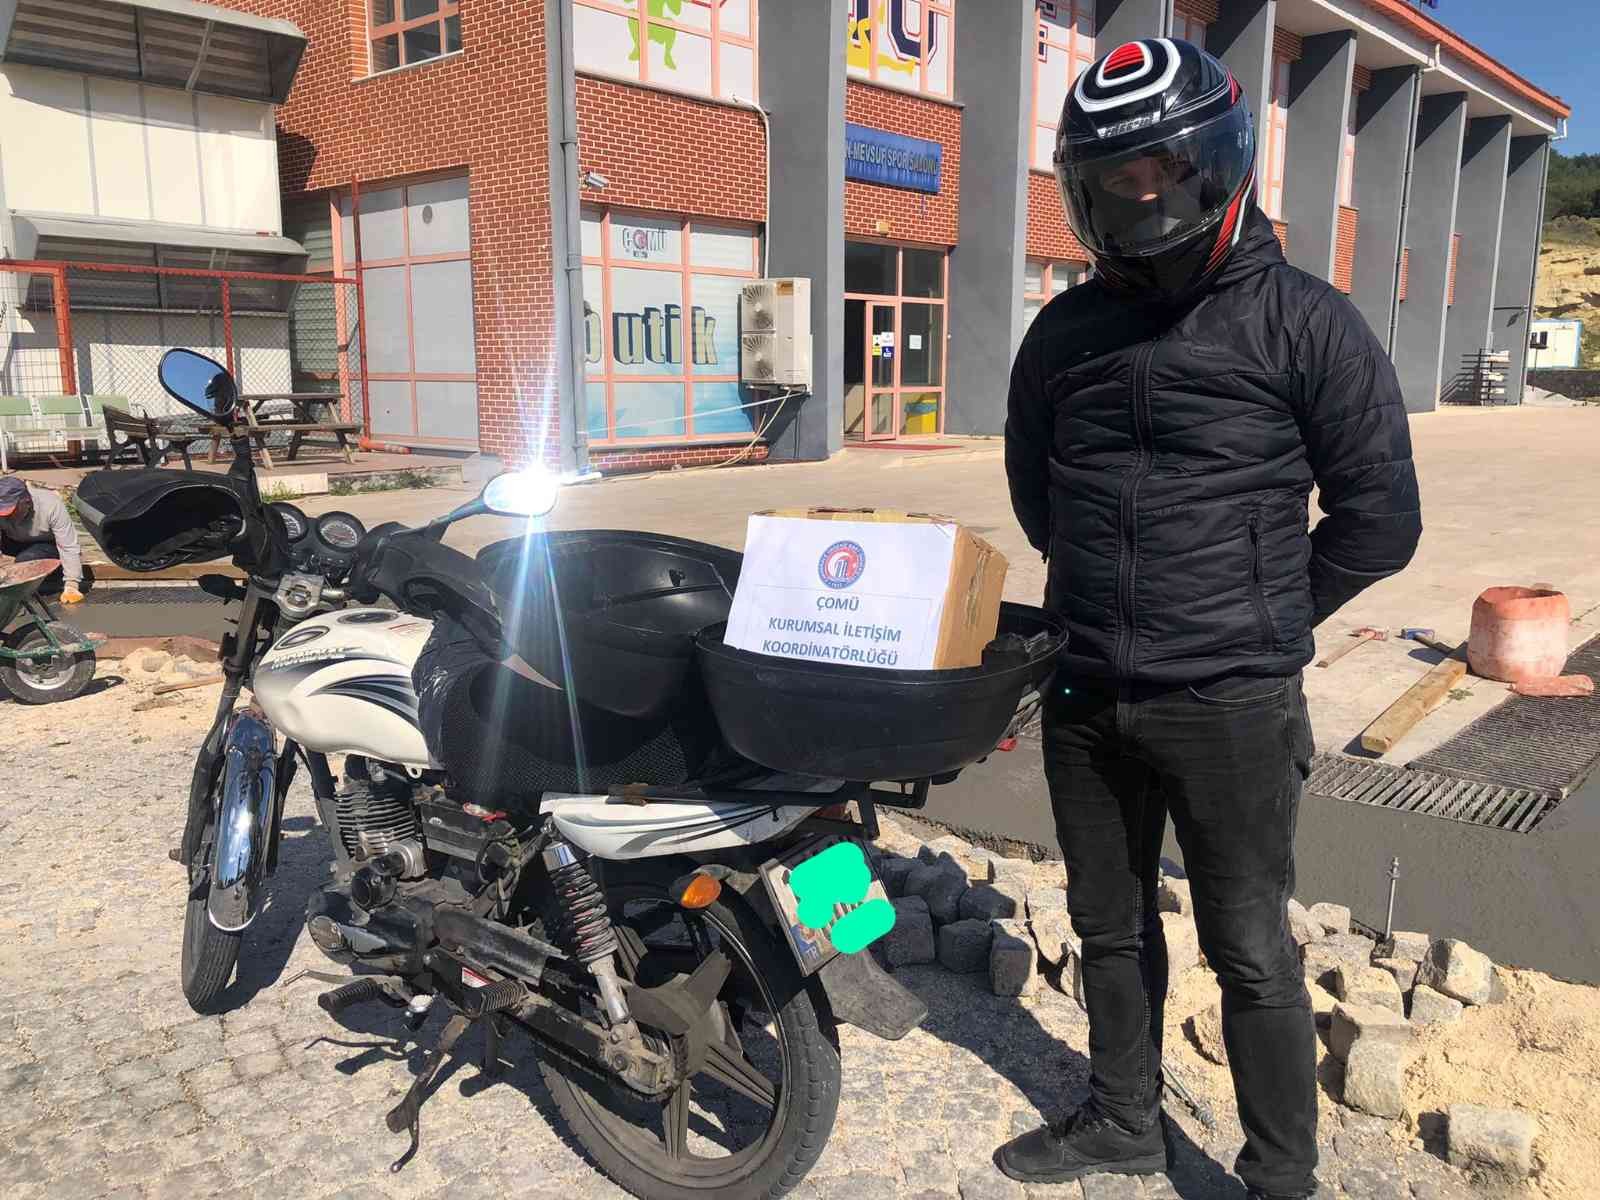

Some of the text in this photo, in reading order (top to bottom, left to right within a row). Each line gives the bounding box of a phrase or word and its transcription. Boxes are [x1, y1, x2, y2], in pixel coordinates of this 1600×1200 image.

[816, 595, 860, 612] ÇOMÜ
[768, 616, 902, 643] KURUMSAL İLETİŞİM
[762, 639, 898, 667] KOORDİNATÖRLÜĞÜ
